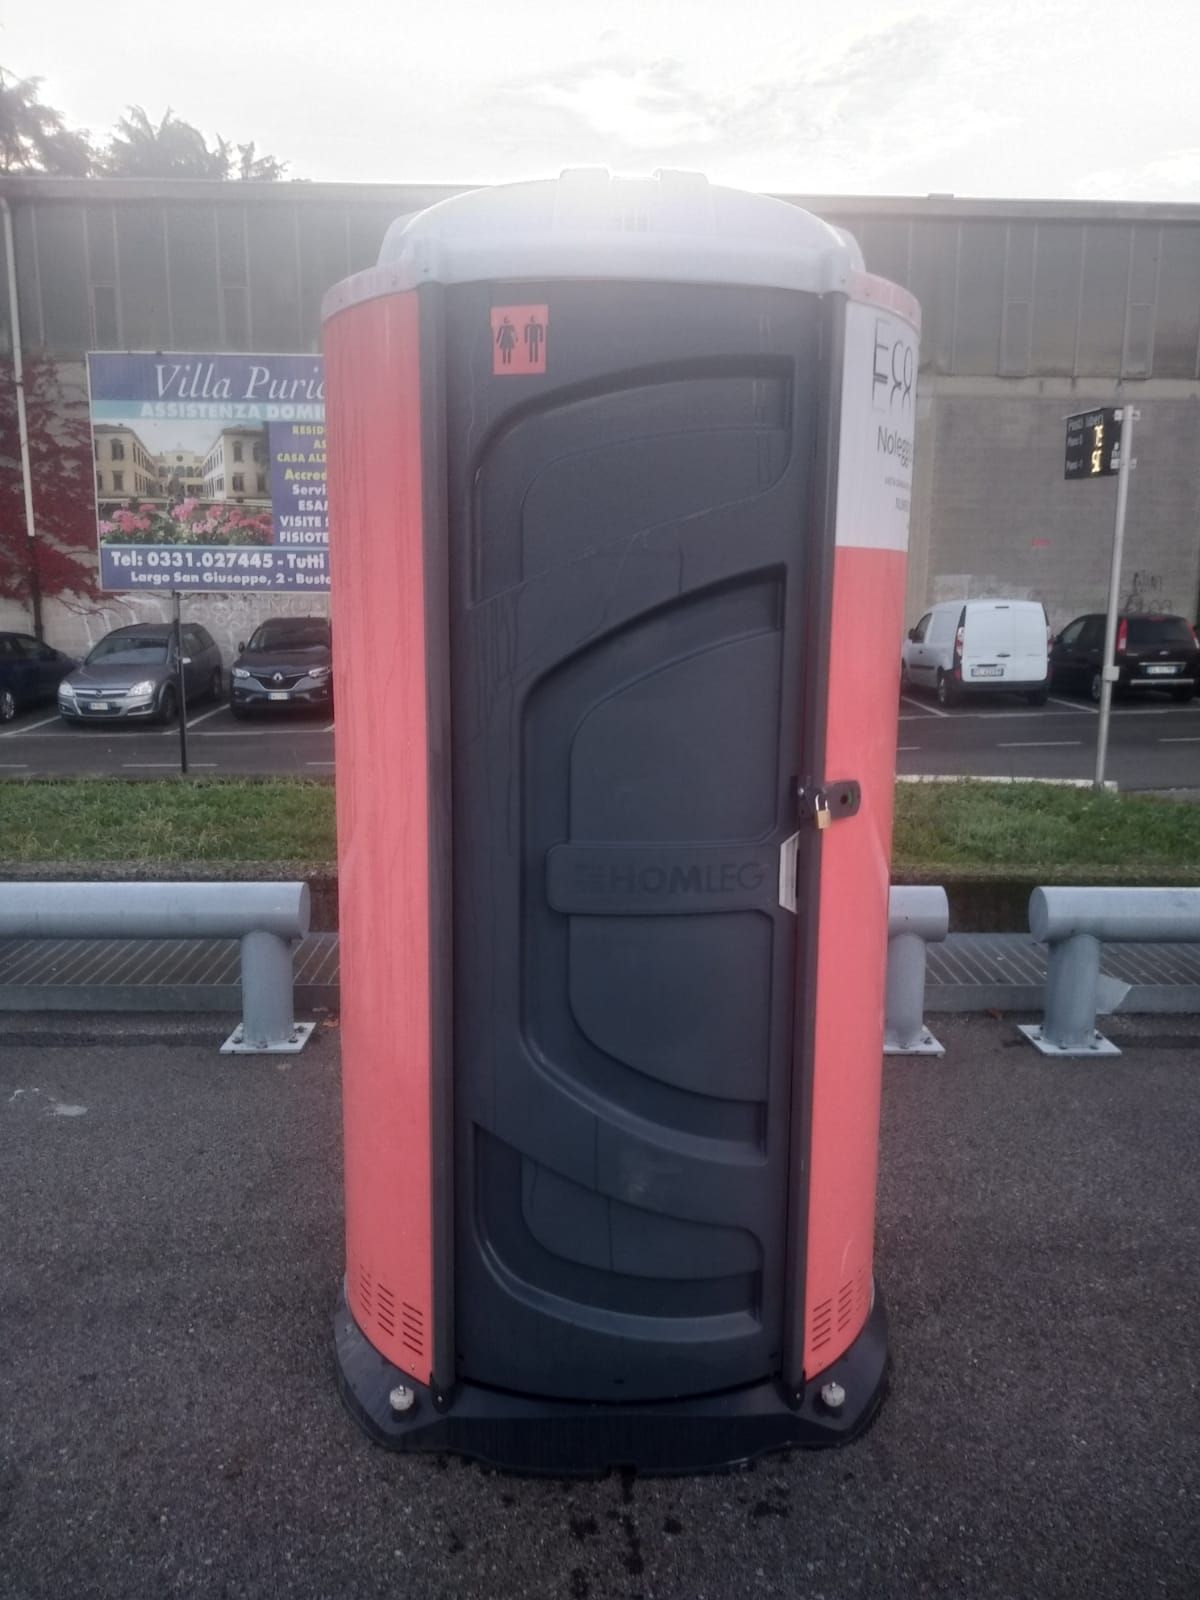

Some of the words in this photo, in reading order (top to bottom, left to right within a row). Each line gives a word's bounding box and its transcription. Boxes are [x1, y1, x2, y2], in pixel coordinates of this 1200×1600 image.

[154, 362, 232, 398] Villa
[140, 403, 260, 418] ASSISTENZA
[266, 404, 326, 419] DOMI
[292, 425, 326, 435] RESID
[276, 453, 306, 463] CASA
[292, 483, 328, 496] Servi
[279, 515, 321, 528] VISITE
[279, 530, 329, 544] FISIOTE
[111, 551, 143, 567] Tel:
[147, 552, 273, 569] 0331.027445
[287, 553, 325, 569] Tutti
[131, 571, 171, 586] Largo
[174, 571, 199, 584] San
[203, 572, 271, 587] Giuseppe,
[275, 573, 285, 585] 2
